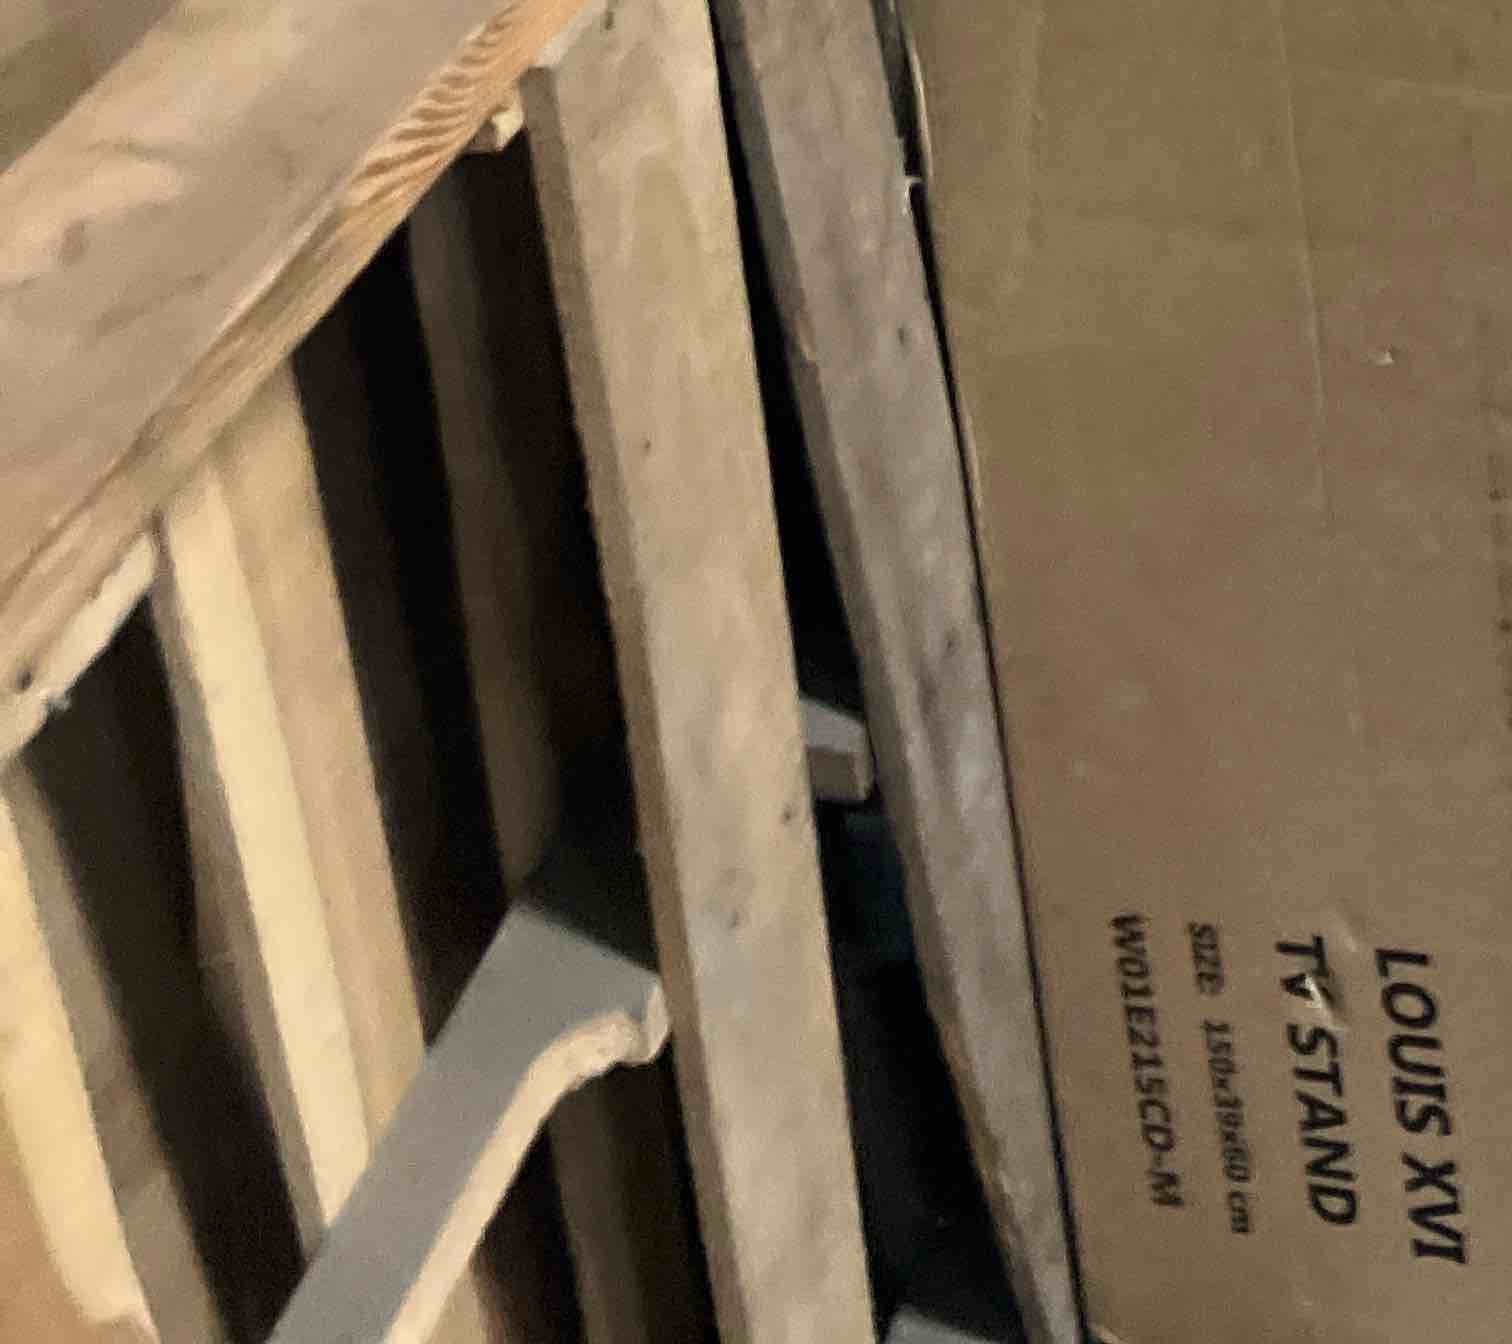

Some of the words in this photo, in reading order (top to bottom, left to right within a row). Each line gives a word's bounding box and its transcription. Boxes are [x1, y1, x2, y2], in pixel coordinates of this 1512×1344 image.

[1285, 1021, 1359, 1226] STAND
[1374, 946, 1454, 1138] LOUIS
[1399, 1151, 1468, 1266] XVI
